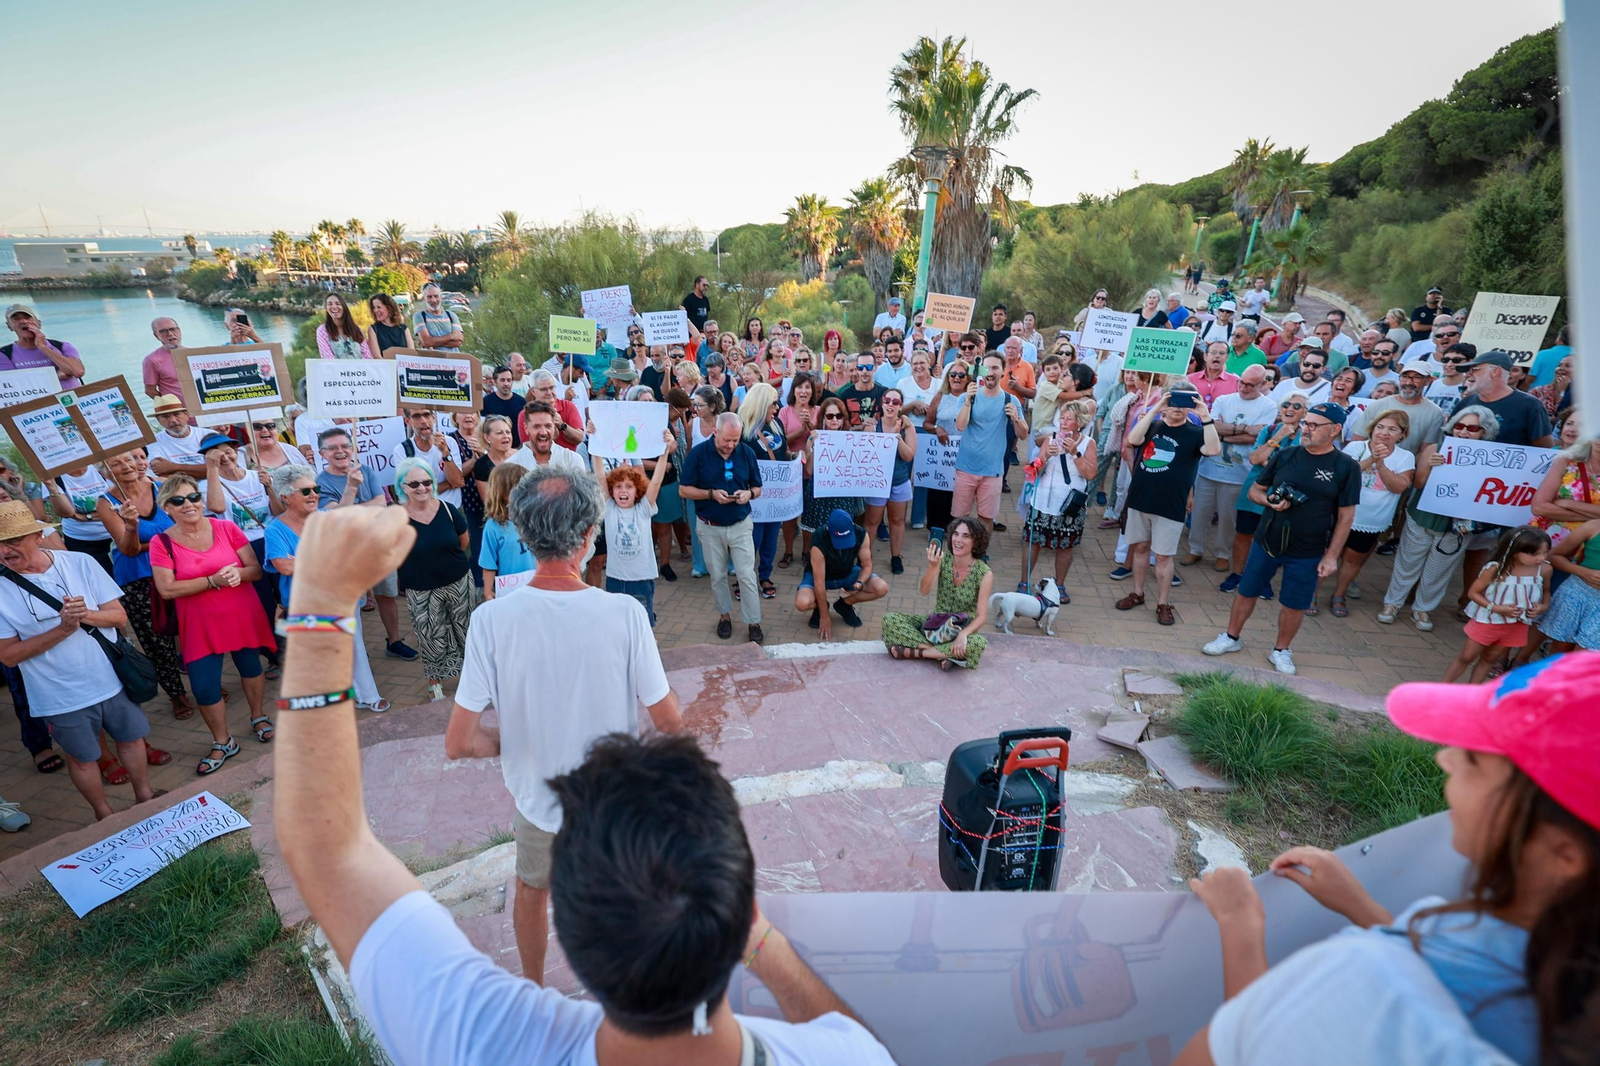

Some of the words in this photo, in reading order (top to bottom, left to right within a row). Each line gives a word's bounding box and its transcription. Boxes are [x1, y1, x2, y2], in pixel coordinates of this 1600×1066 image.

[584, 292, 597, 302] EL
[1491, 294, 1547, 308] DERECHO
[1495, 313, 1548, 325] DESCANSO
[1152, 339, 1188, 347] TERRAZAS
[192, 360, 218, 370] ESTAMOS
[324, 379, 381, 387] ESPECULACIÓN
[21, 388, 48, 396] LOCAL
[204, 394, 236, 403] BEARDO
[237, 390, 276, 400] CIERRALOS
[79, 397, 106, 410] ¡BASTA
[106, 392, 118, 401] YA!
[21, 413, 49, 428] ¡BASTA
[50, 408, 64, 418] YA!
[820, 433, 834, 446] EL
[845, 433, 894, 449] PUERTO
[818, 448, 880, 464] AVANZA
[1446, 446, 1527, 469] ¡BASTA
[819, 465, 830, 475] EN
[834, 465, 884, 477] SUELDOS
[840, 479, 852, 488] LOS
[1436, 483, 1459, 498] DE
[169, 796, 209, 819] YA!
[90, 854, 125, 874] DE
[100, 865, 151, 890] EL
